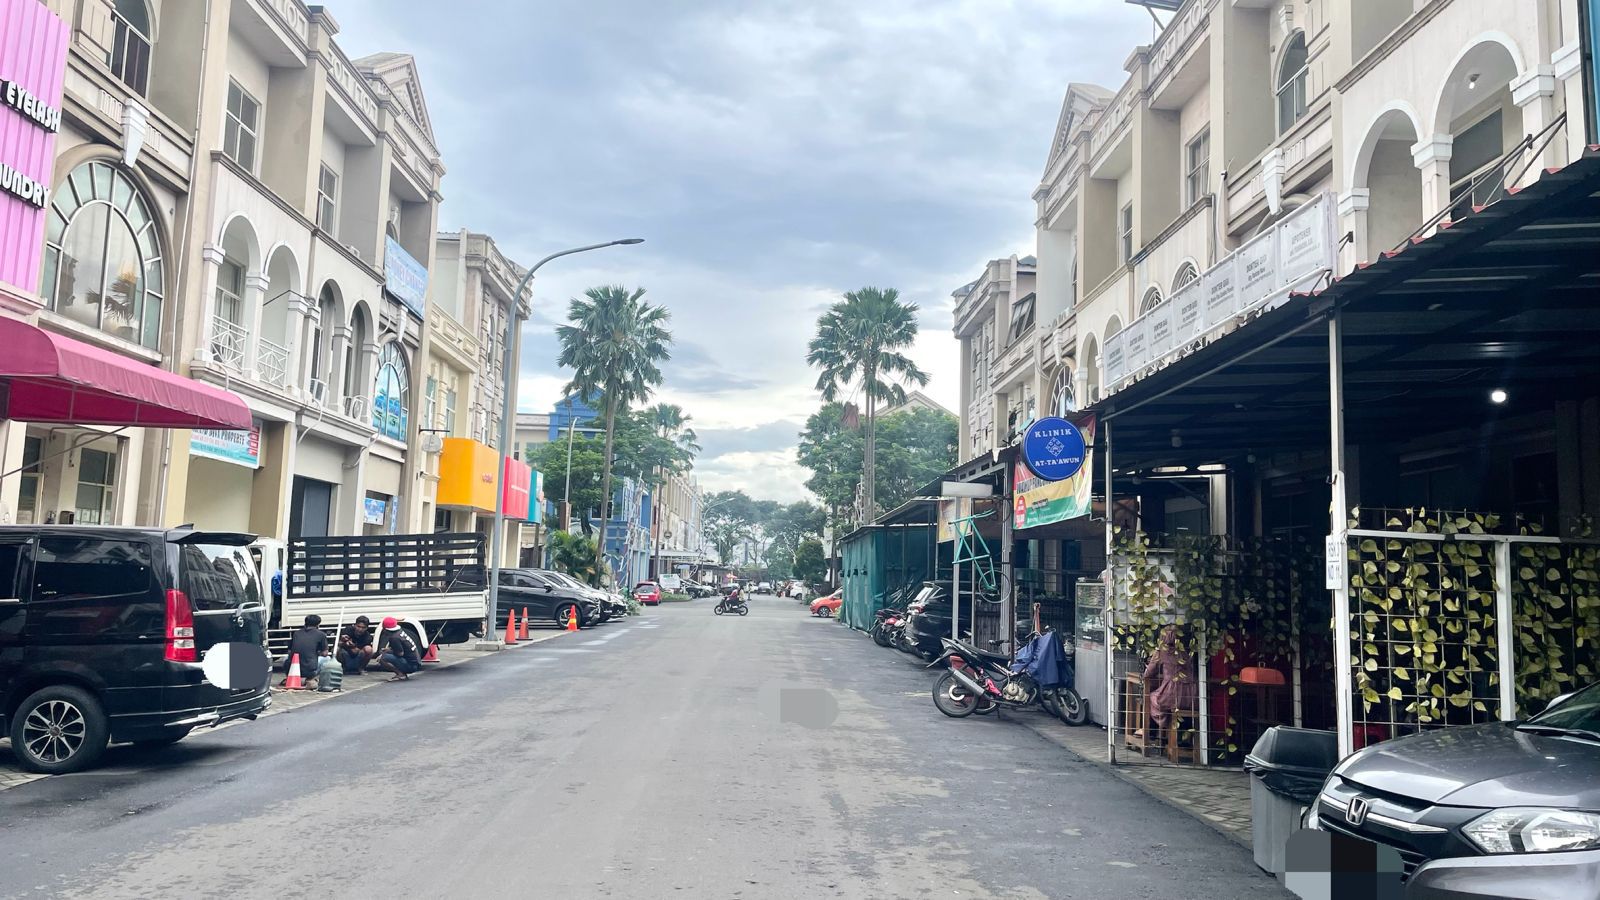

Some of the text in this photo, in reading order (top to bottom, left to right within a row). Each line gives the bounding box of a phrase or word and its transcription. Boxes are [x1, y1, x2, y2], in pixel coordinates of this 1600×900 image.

[6, 80, 61, 133] EYELASH
[1034, 428, 1072, 438] KLINIK
[1035, 457, 1080, 467] AT-TA'AWUN
